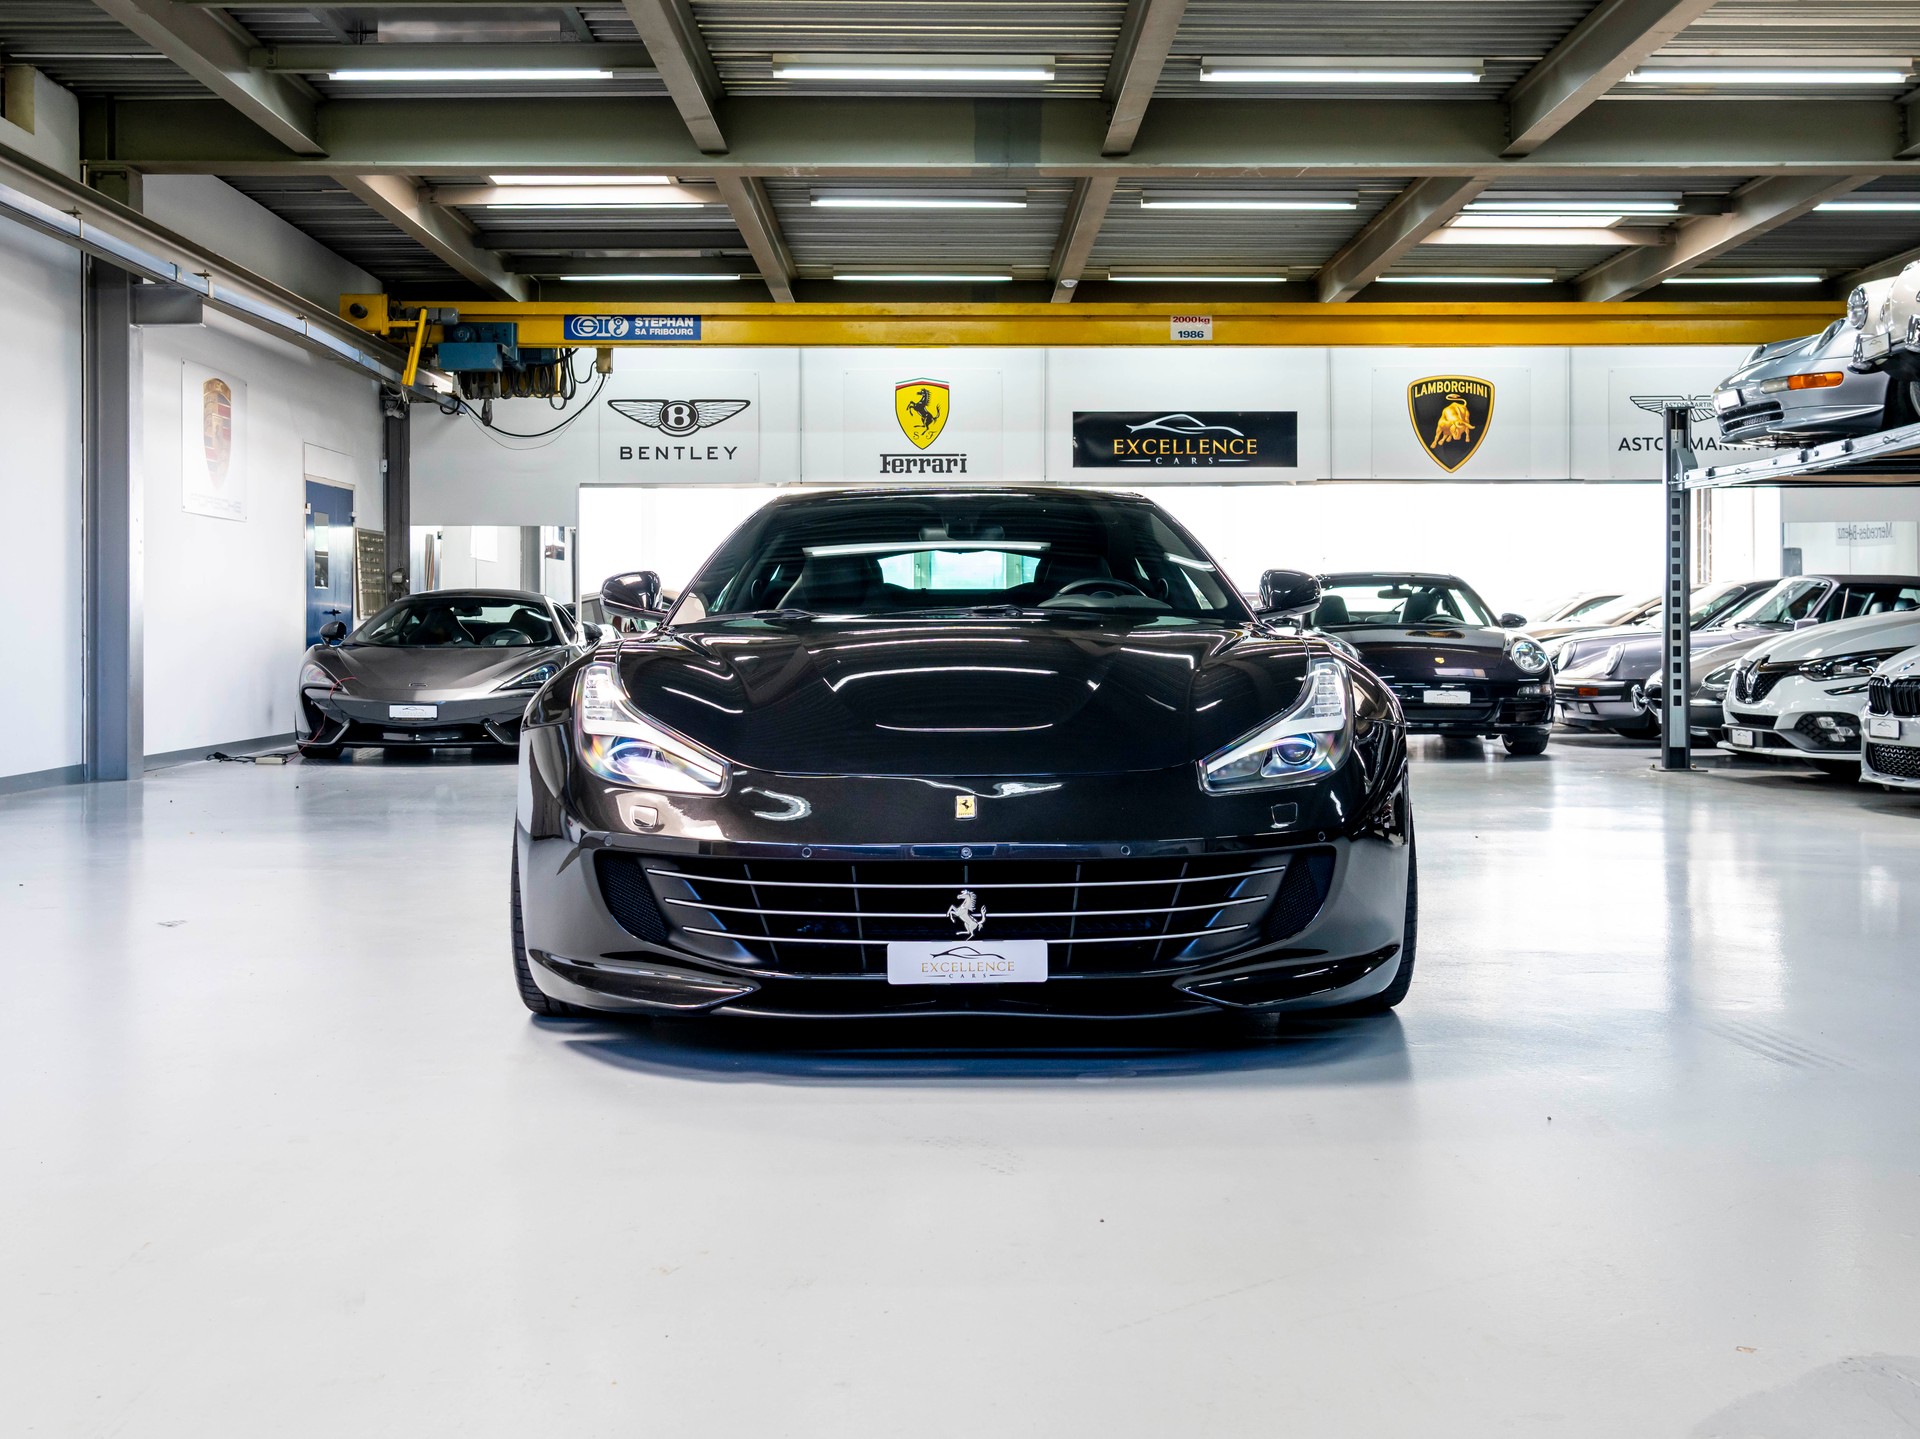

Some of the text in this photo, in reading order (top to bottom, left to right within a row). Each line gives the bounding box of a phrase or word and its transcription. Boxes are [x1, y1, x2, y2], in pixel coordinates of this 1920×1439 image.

[634, 317, 694, 327] STEPHAN
[634, 328, 694, 336] SA FRIBOURG
[1177, 330, 1204, 338] 1986
[1414, 380, 1488, 398] LAMBORGHINI
[667, 404, 690, 428] B
[912, 431, 920, 440] S
[1113, 439, 1258, 455] EXCELLENCE
[1617, 436, 1664, 451] ASTO
[619, 446, 738, 460] BENTLEY
[879, 453, 967, 474] Ferrari
[1155, 456, 1214, 465] CARS
[921, 961, 1015, 973] EXCELLENCE
